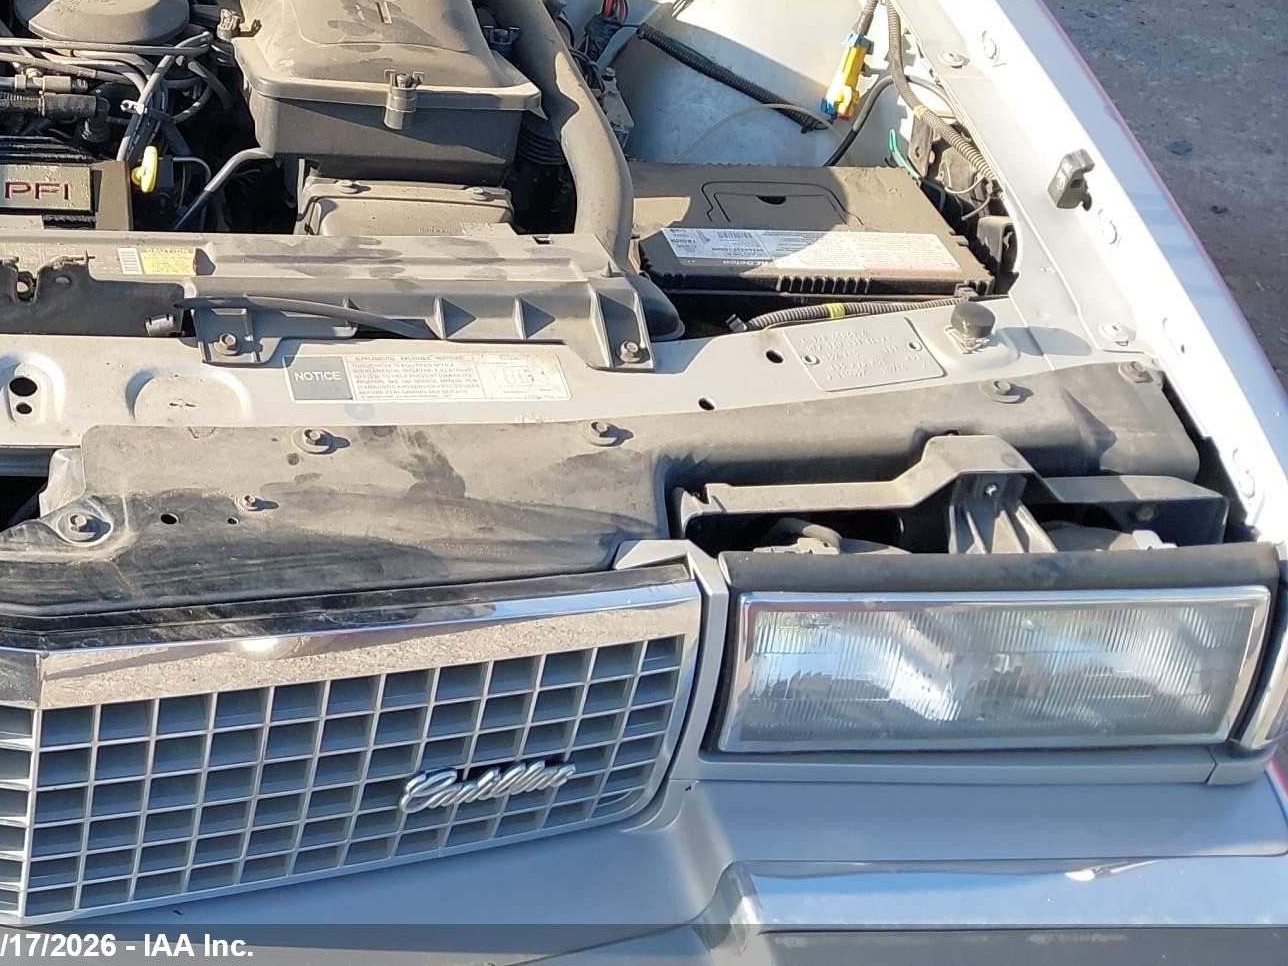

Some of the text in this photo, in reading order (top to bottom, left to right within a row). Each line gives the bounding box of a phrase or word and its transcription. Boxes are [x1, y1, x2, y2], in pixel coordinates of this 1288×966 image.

[4, 181, 71, 200] PFI
[294, 370, 342, 382] NOTICE
[399, 760, 577, 814] Cadillac
